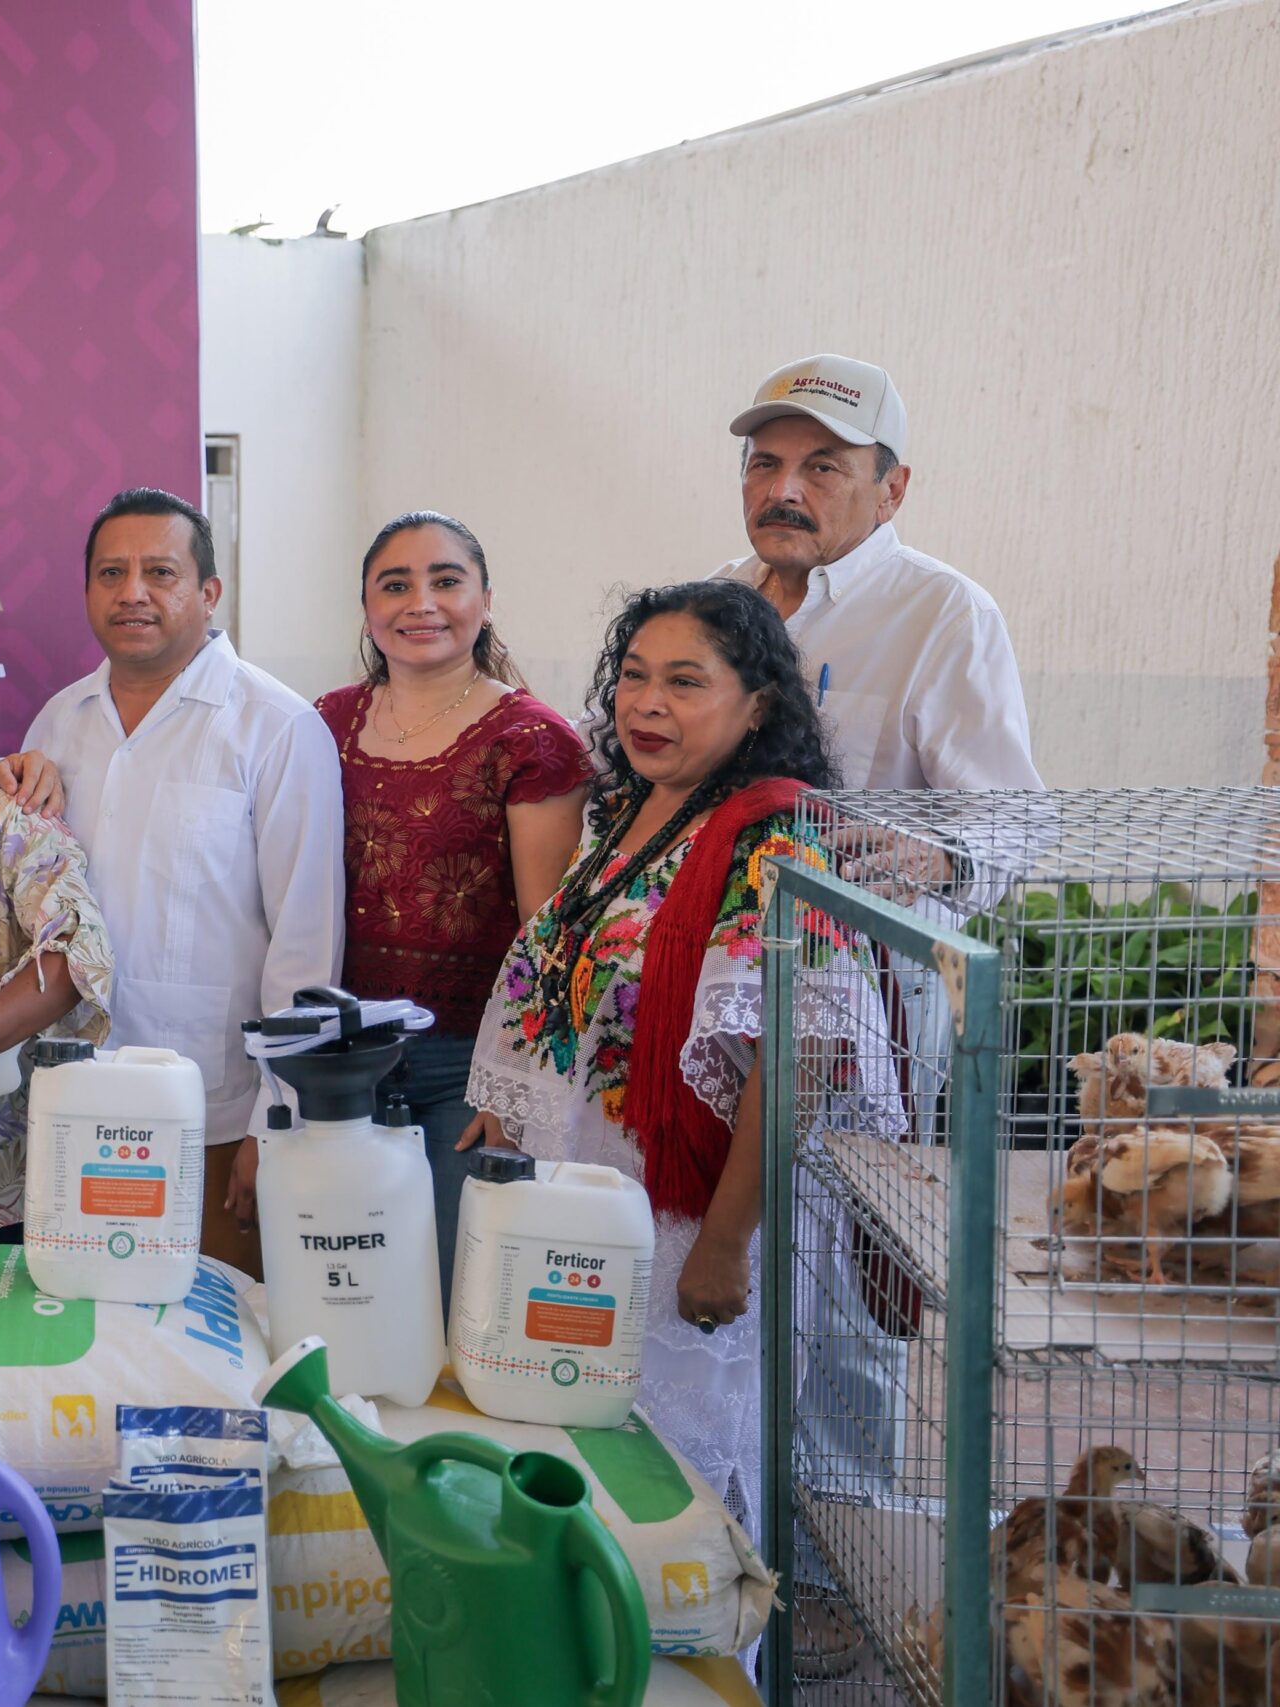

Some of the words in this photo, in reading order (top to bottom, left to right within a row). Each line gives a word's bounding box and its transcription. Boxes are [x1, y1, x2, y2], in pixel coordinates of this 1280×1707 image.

[793, 377, 862, 399] Agricultura
[96, 1125, 154, 1142] Ferticor
[300, 1233, 386, 1251] TRUPER
[546, 1249, 606, 1271] Ferticor
[328, 1272, 341, 1287] 5
[347, 1272, 359, 1287] L
[183, 1258, 244, 1359] AMPI
[140, 1562, 255, 1586] HIDROMET
[272, 1570, 391, 1619] mpipo
[245, 1695, 249, 1703] 1
[250, 1694, 264, 1706] kg
